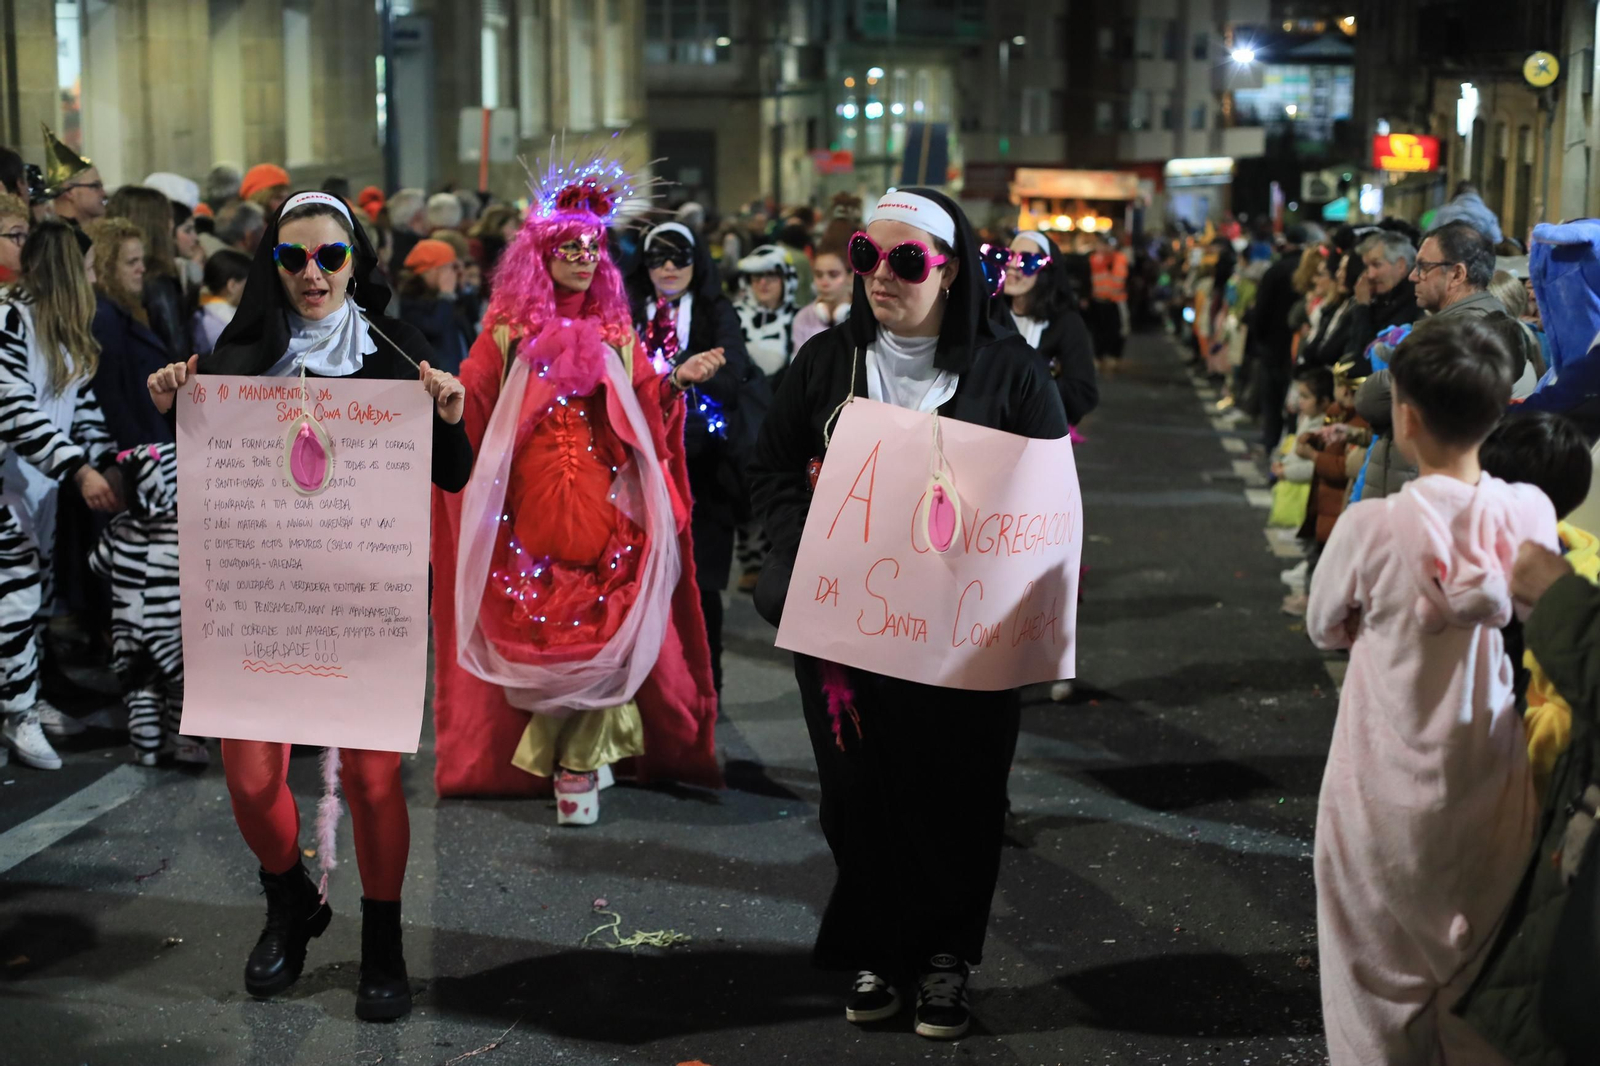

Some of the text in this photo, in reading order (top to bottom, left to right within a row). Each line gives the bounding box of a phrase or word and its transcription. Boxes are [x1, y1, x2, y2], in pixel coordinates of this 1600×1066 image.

[217, 383, 229, 403] 10
[239, 384, 309, 401] MANDAMENTOS
[316, 391, 332, 401] DA
[314, 403, 341, 422] CONA
[369, 439, 378, 450] DA
[344, 460, 366, 471] TODAS
[369, 460, 379, 470] AS
[827, 440, 881, 543] A
[260, 499, 266, 509] A
[276, 520, 281, 529] A
[360, 518, 372, 528] EN
[261, 539, 283, 549] ACTOS
[279, 580, 286, 590] A
[370, 582, 379, 592] DE
[233, 600, 247, 611] TEU
[815, 576, 840, 606] DA
[857, 558, 927, 643] SANTA
[379, 626, 385, 637] A
